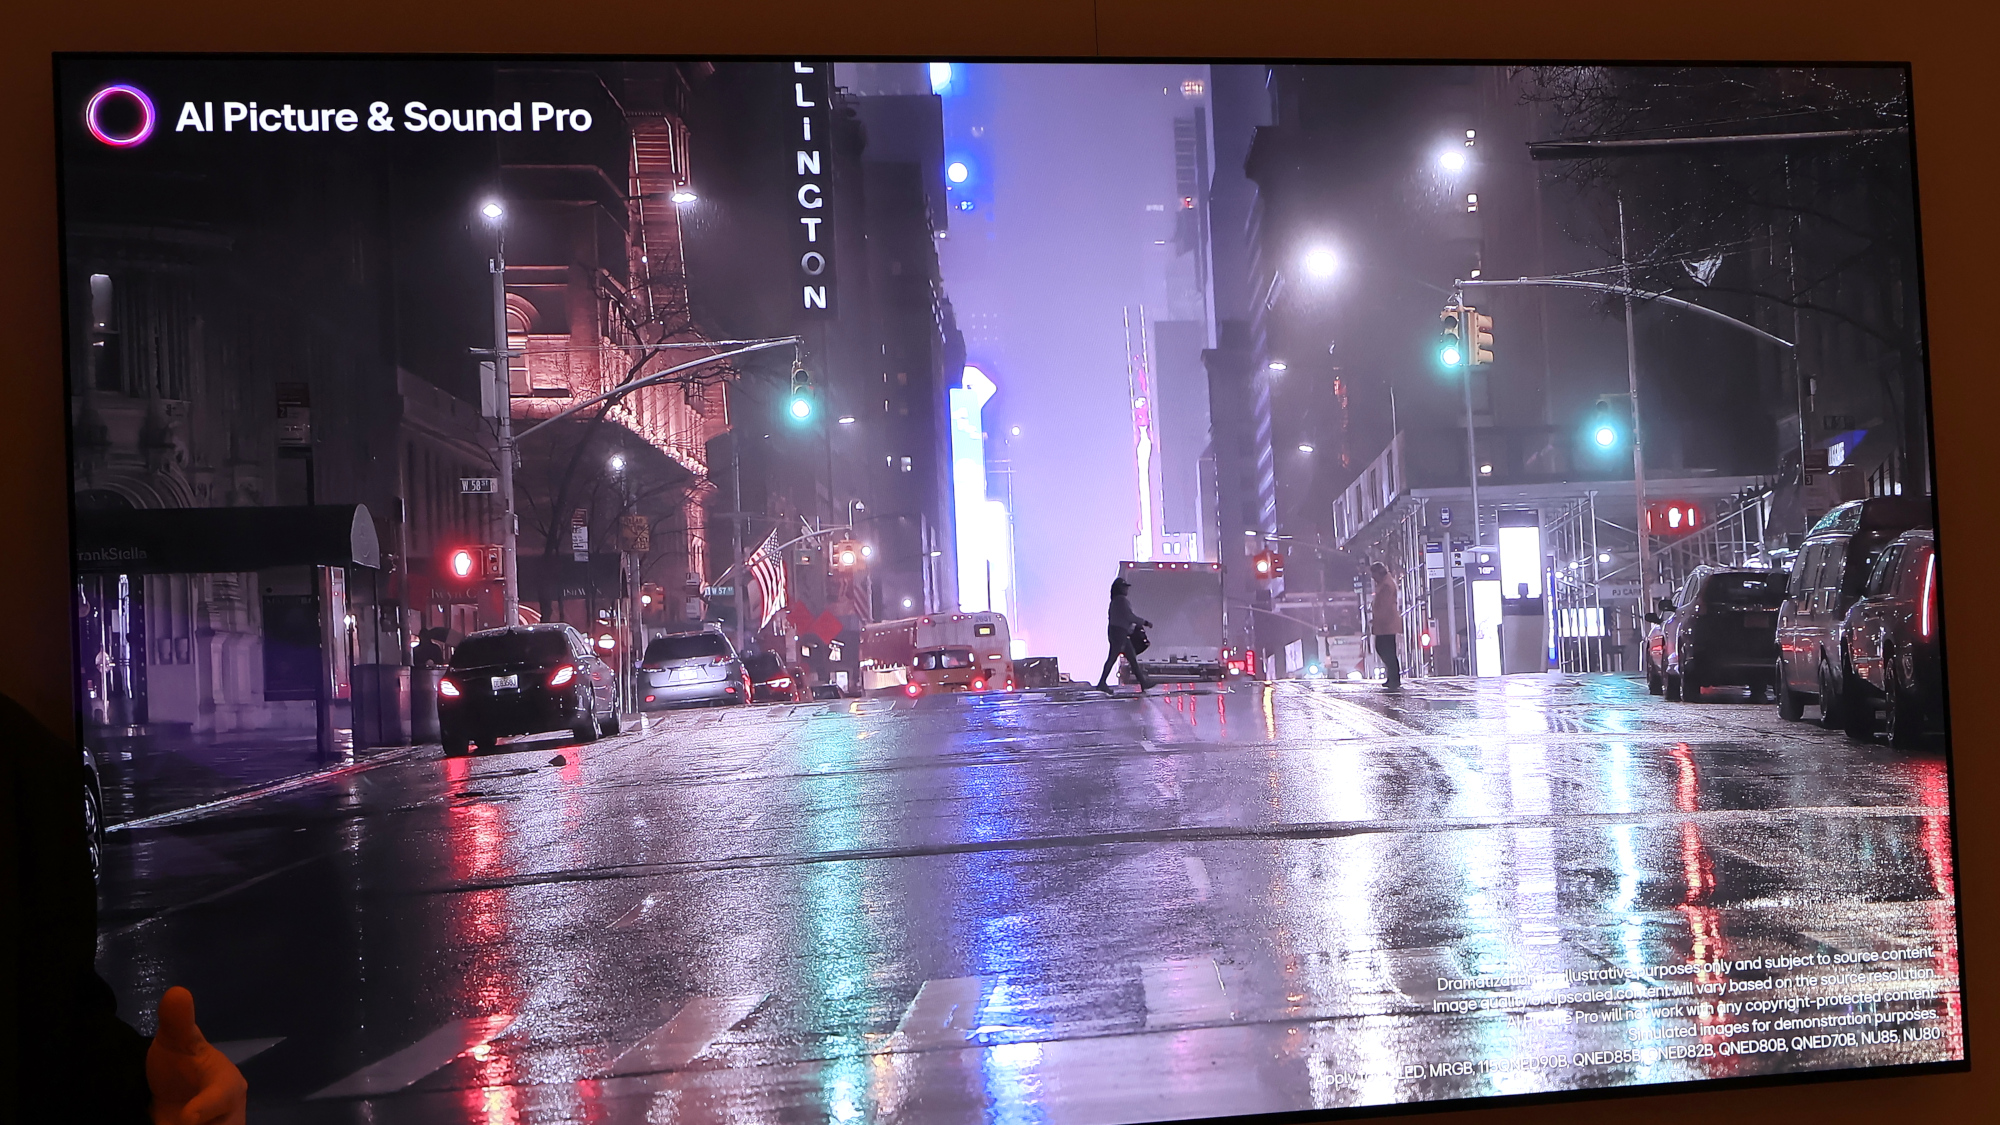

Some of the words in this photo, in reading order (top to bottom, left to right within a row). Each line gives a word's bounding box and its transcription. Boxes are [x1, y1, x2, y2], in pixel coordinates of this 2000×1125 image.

[175, 102, 213, 132] AI
[224, 101, 358, 132] Picture
[367, 101, 395, 132] &
[404, 101, 522, 132] Sound
[532, 101, 592, 132] Pro
[462, 480, 469, 491] W
[471, 480, 481, 491] 58
[76, 546, 148, 561] rankStella
[711, 587, 717, 595] W
[718, 587, 727, 595] 57
[1437, 972, 1536, 991] Dramatization
[1562, 965, 1632, 982] illustrative
[1637, 962, 1701, 980] purposes
[1704, 957, 1730, 974] only
[1735, 955, 1761, 970] and
[1764, 952, 1814, 969] subject
[1817, 952, 1830, 964] to
[1834, 950, 1878, 963] source
[1881, 944, 1936, 960] content.
[1433, 998, 1476, 1013] Image
[1480, 993, 1526, 1012] quality
[1530, 991, 1545, 1005] of
[1550, 986, 1612, 1006] upscaled
[1616, 984, 1668, 999] content
[1672, 981, 1692, 995] will
[1696, 982, 1726, 995] vary
[1730, 975, 1772, 992] based
[1775, 977, 1792, 988] on
[1795, 973, 1816, 987] the
[1820, 972, 1865, 985] source
[1868, 965, 1937, 982] resolution.
[1506, 1014, 1519, 1028] AI
[1524, 1013, 1572, 1027] Picture
[1575, 1009, 1598, 1023] Pro
[1600, 1007, 1622, 1021] will
[1625, 1006, 1648, 1020] not
[1651, 1002, 1682, 1018] work
[1686, 1000, 1712, 1015] with
[1717, 1002, 1740, 1015] any
[1745, 988, 1880, 1013] copyright-protected
[1884, 986, 1938, 1001] content.
[1628, 1022, 1696, 1040] Simulated
[1700, 1021, 1748, 1036] images
[1752, 1018, 1770, 1031] for
[1774, 1010, 1870, 1030] demonstration
[1875, 1008, 1938, 1025] purposes.
[1315, 1069, 1356, 1088] Apply
[1430, 1061, 1474, 1077] MRGB,
[1478, 1053, 1569, 1073] 115QNED90B,
[1573, 1048, 1642, 1067] QNED85B,
[1648, 1042, 1715, 1062] QNED82B,
[1718, 1037, 1788, 1056] QNED80B,
[1791, 1032, 1858, 1051] QNED70B,
[1861, 1029, 1900, 1044] NU85,
[1903, 1025, 1940, 1041] NU80
